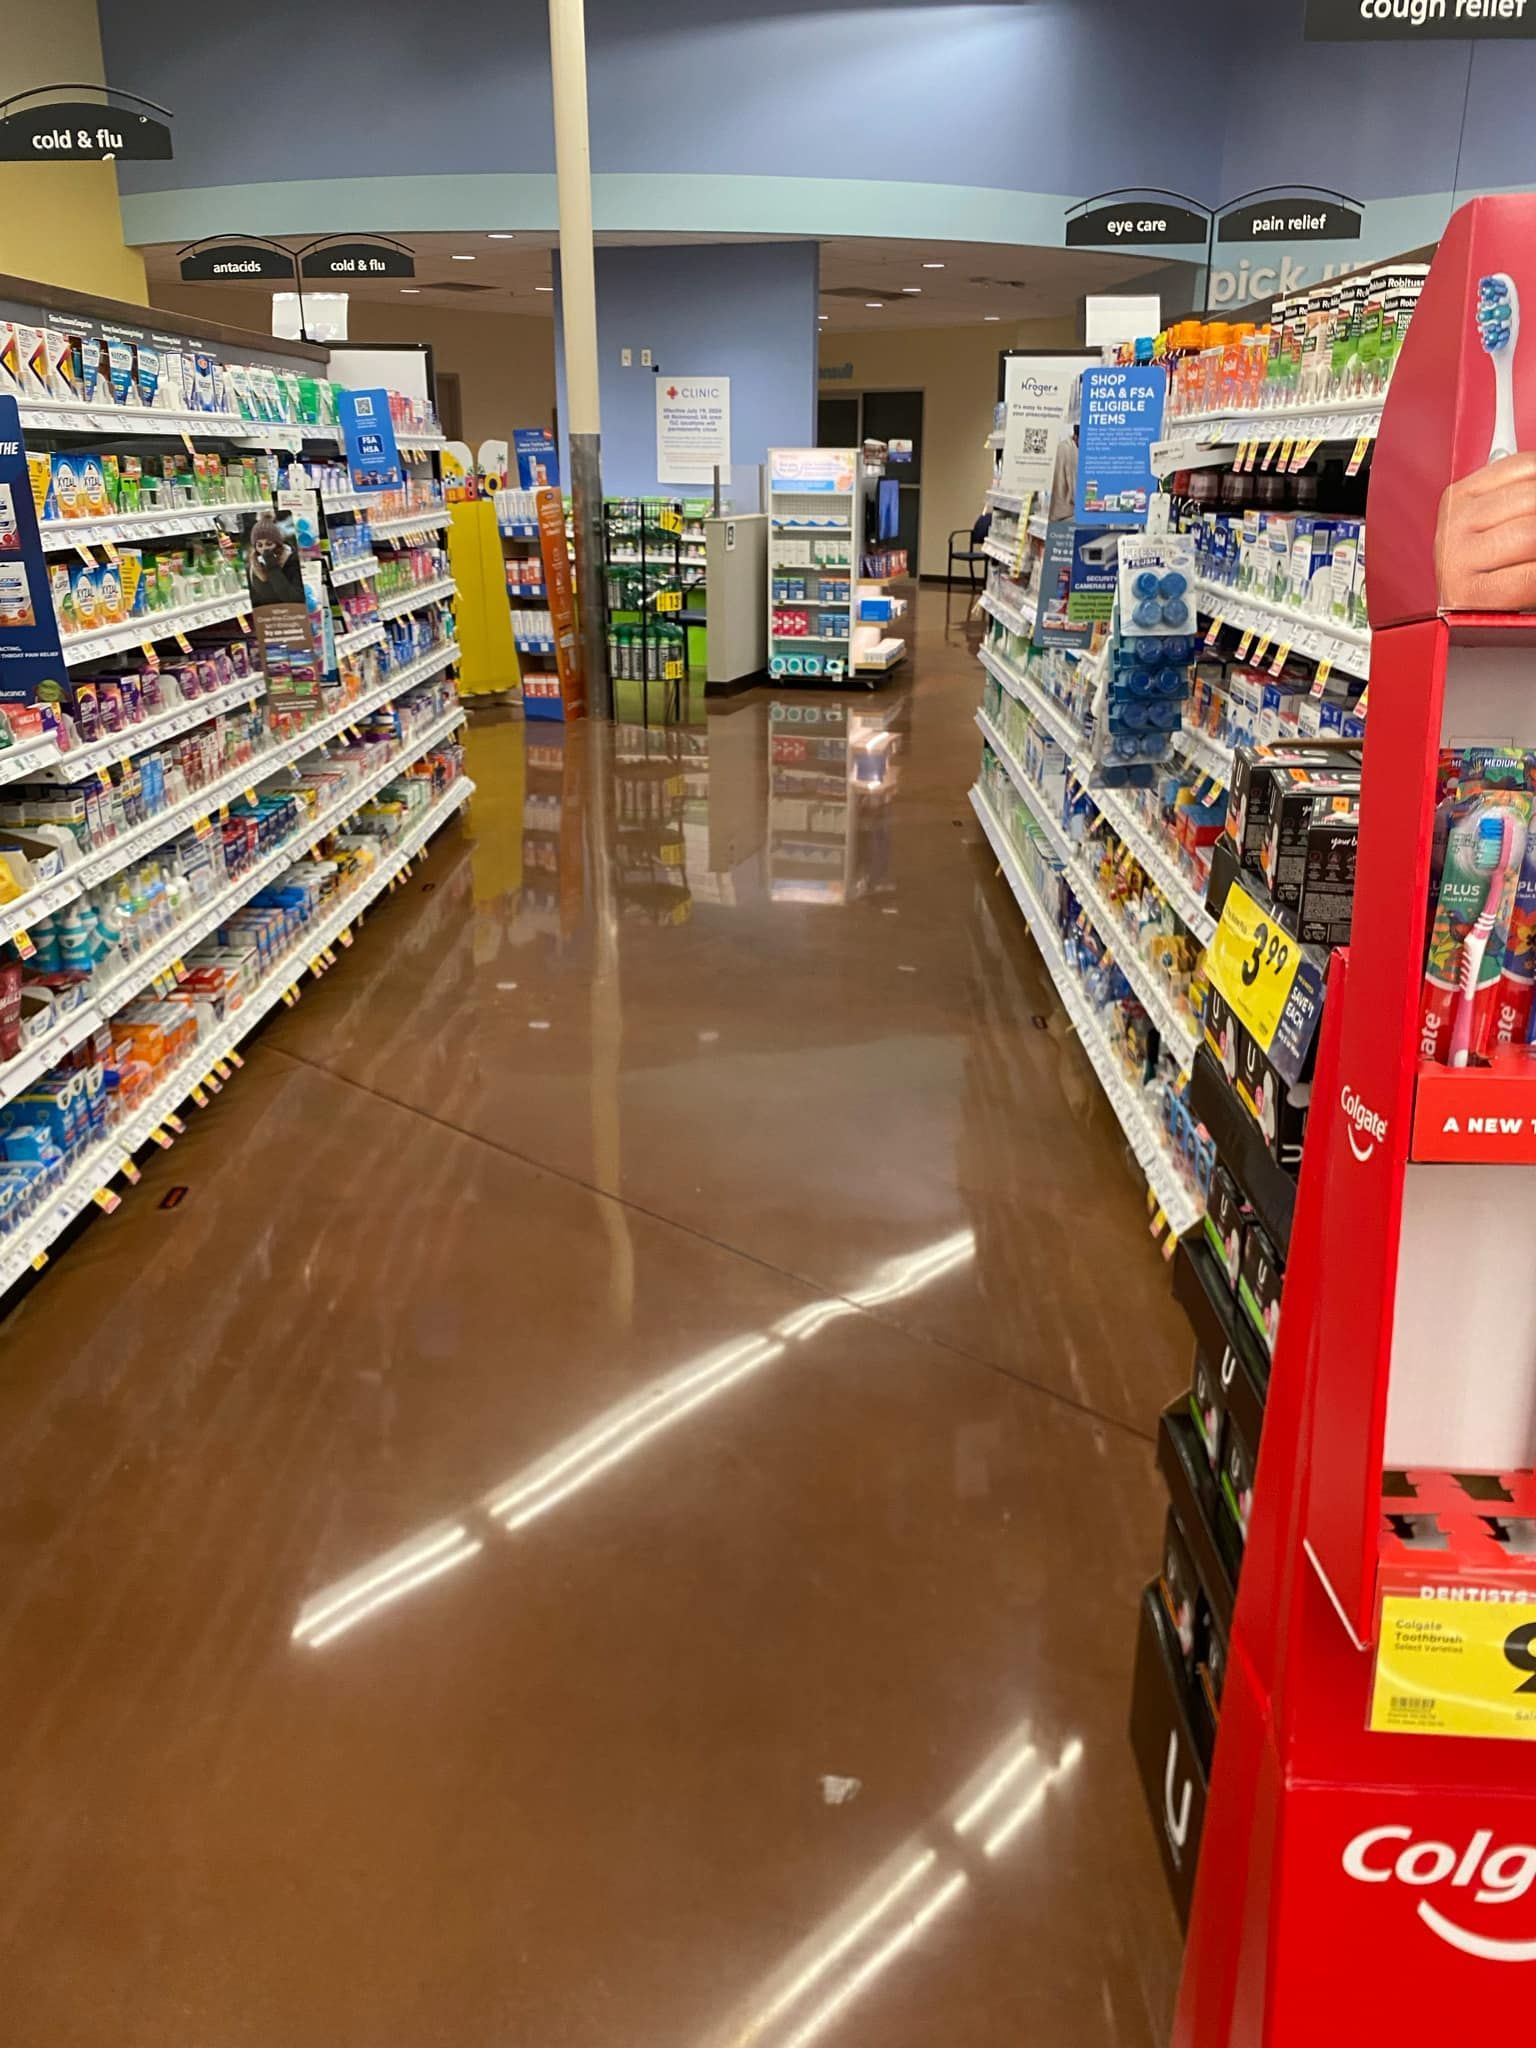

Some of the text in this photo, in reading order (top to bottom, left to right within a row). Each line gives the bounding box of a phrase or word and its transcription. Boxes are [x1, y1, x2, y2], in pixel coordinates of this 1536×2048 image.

[1360, 0, 1528, 25] cough relief
[32, 128, 123, 149] cold & flu
[1107, 219, 1167, 236] eye care
[1252, 213, 1328, 234] pain relief
[213, 259, 262, 274] antacids
[330, 259, 386, 272] cold & flu
[1208, 255, 1305, 308] pick
[1090, 374, 1126, 386] SHOP
[681, 387, 720, 399] CLINIC
[1021, 377, 1053, 397] Kroger
[1089, 387, 1155, 399] HSA & FSA
[1089, 400, 1146, 412] ELIGIBLE
[1088, 413, 1126, 425] ITEMS
[362, 436, 377, 444] FSA
[362, 445, 380, 454] HSA
[57, 476, 77, 488] XYZAL
[84, 476, 102, 487] XYZAL
[1086, 575, 1118, 583] SECURITY
[77, 588, 95, 599] XYZAL
[1484, 758, 1518, 769] MEDIUM
[1331, 838, 1351, 850] your
[1443, 882, 1481, 897] PLUS
[1285, 1001, 1304, 1030] EACH
[1420, 1010, 1442, 1060] ate
[1341, 1085, 1388, 1143] Colgate
[1443, 1116, 1460, 1133] A
[1467, 1117, 1523, 1134] NEW
[1395, 1619, 1443, 1632] Colgate
[1395, 1631, 1463, 1644] Toothbrush
[1394, 1643, 1464, 1654] Select Varieties
[1341, 1823, 1536, 1904] Colg
